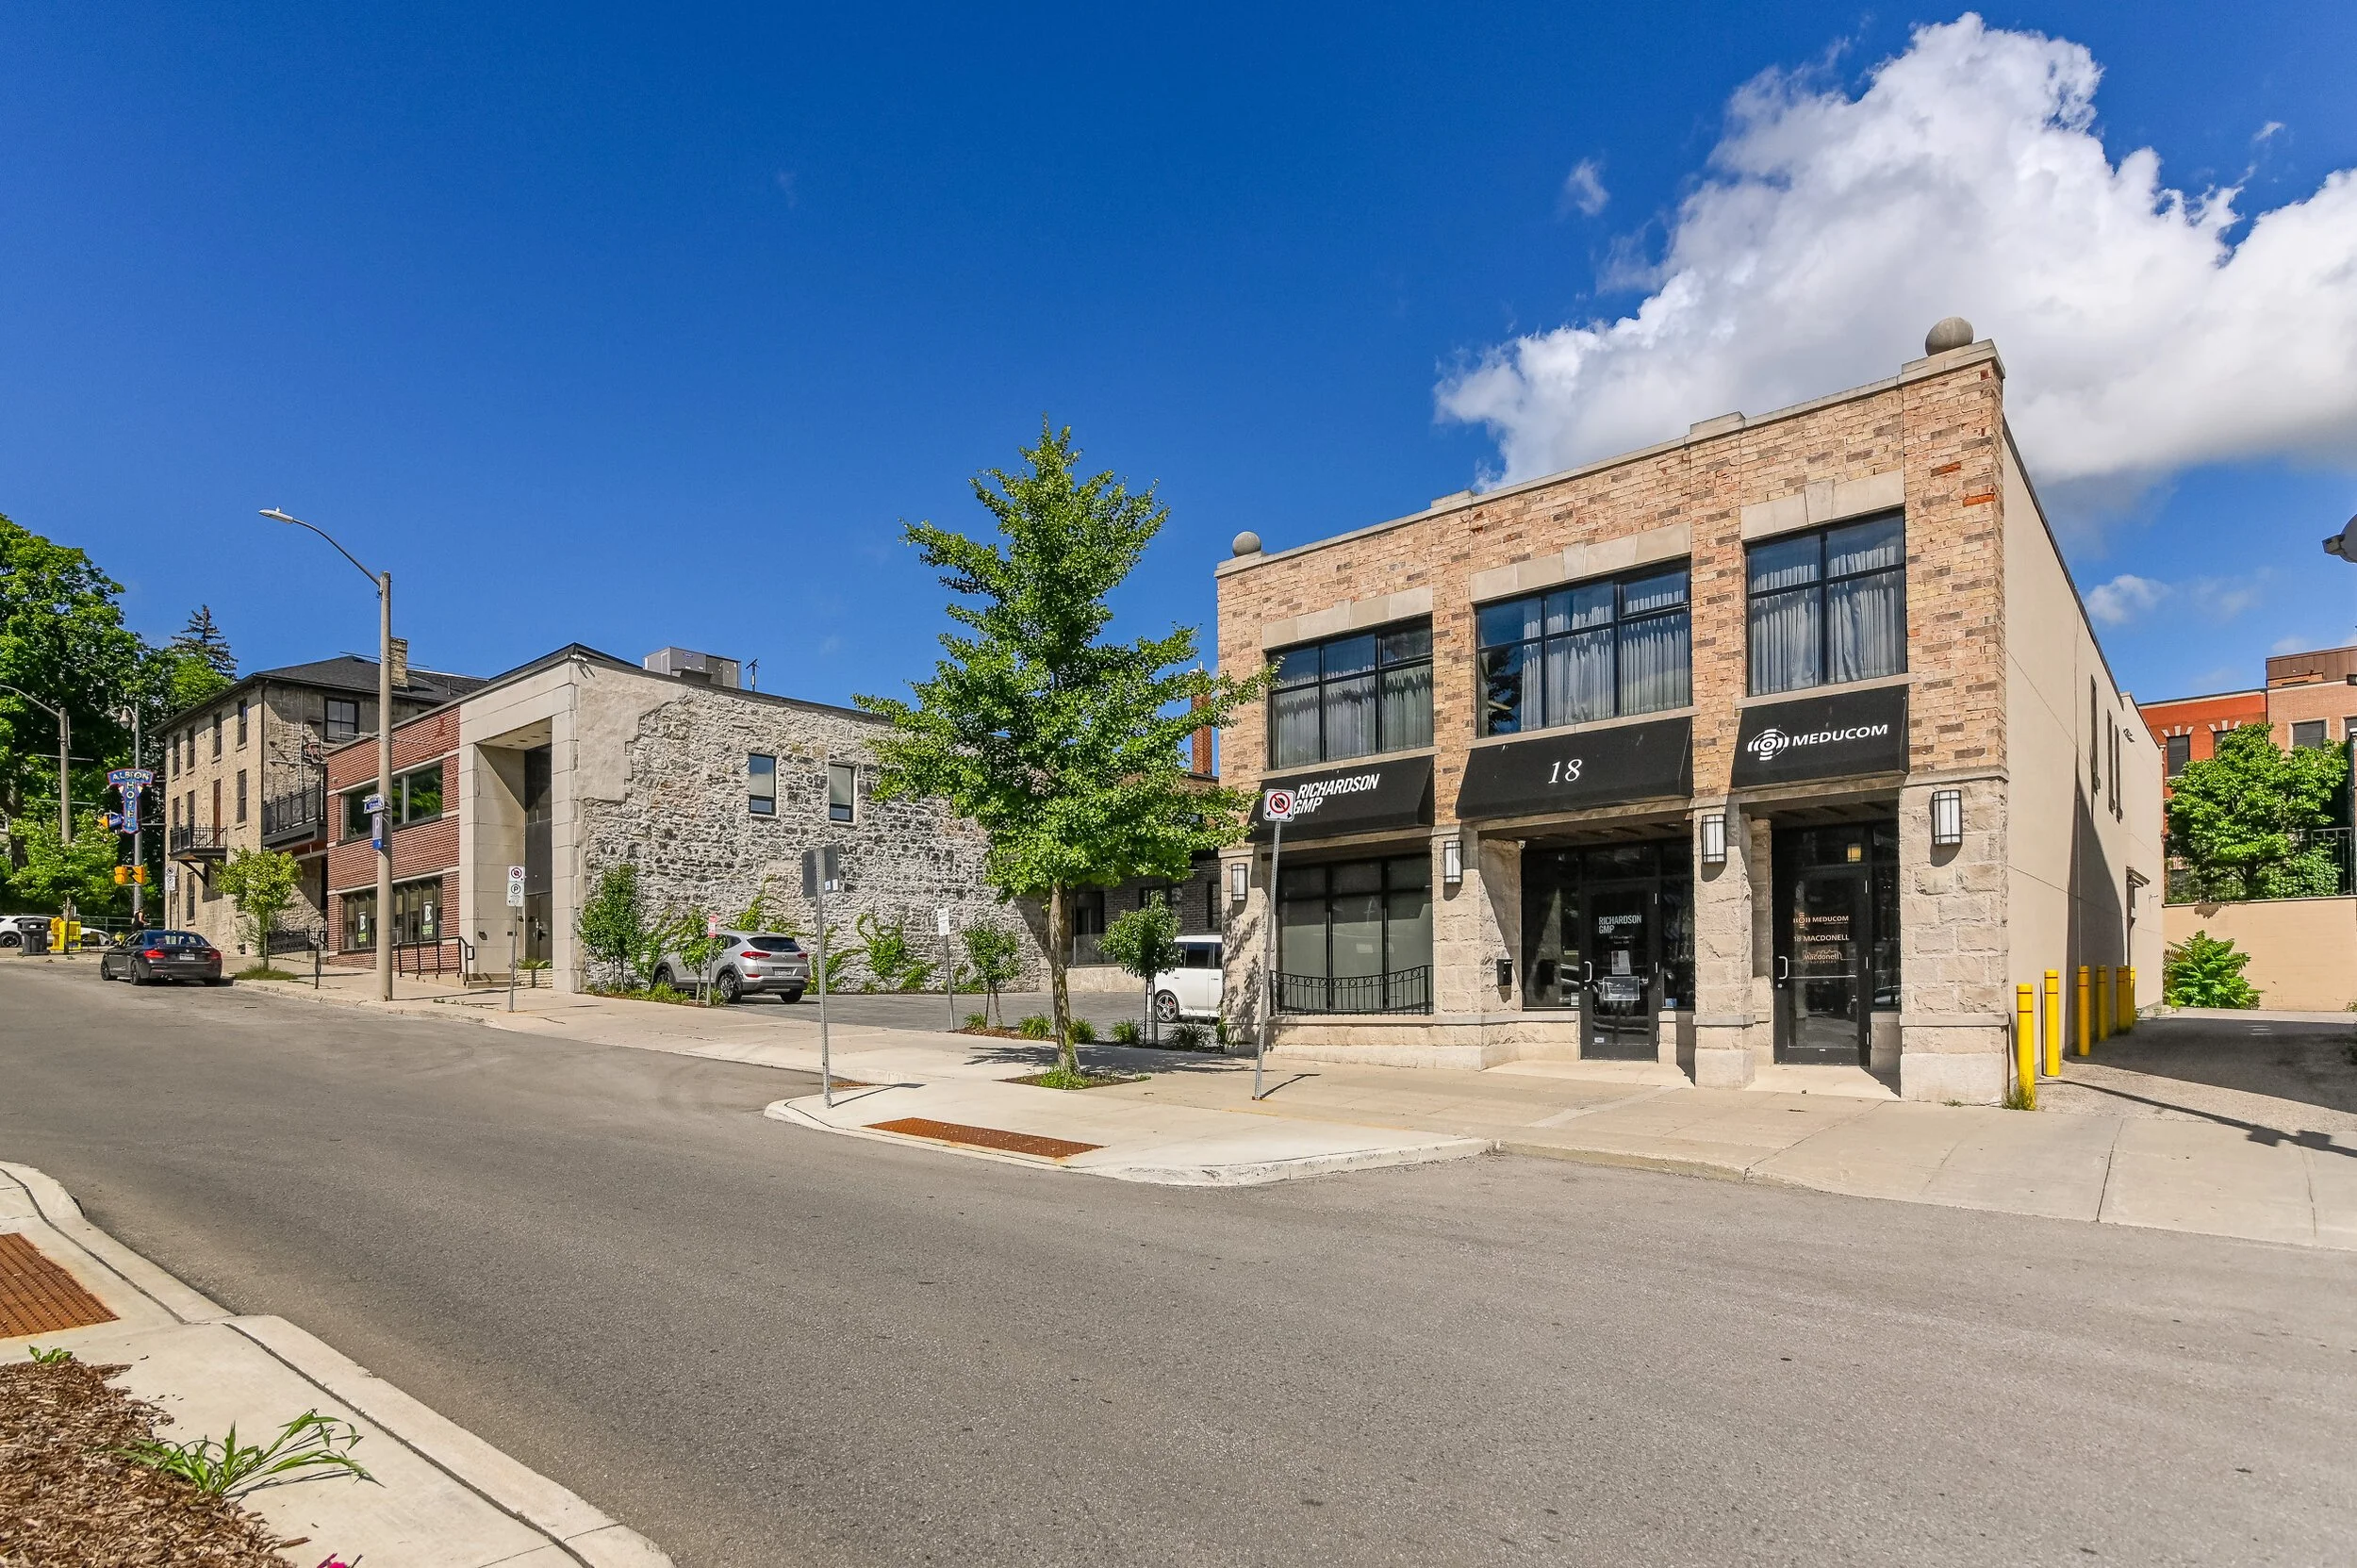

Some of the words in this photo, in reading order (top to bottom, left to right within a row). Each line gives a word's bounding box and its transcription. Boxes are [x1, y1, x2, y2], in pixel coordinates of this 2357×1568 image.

[1792, 724, 1888, 747] MEDUCOM
[112, 771, 150, 780] ALBION
[1548, 758, 1583, 784] 18
[1296, 773, 1380, 800] RICHARDSON
[1294, 797, 1324, 815] GMP
[1598, 915, 1641, 924] RICHARDSON
[1598, 925, 1614, 933] GMP
[1803, 933, 1850, 942] MACDONELL
